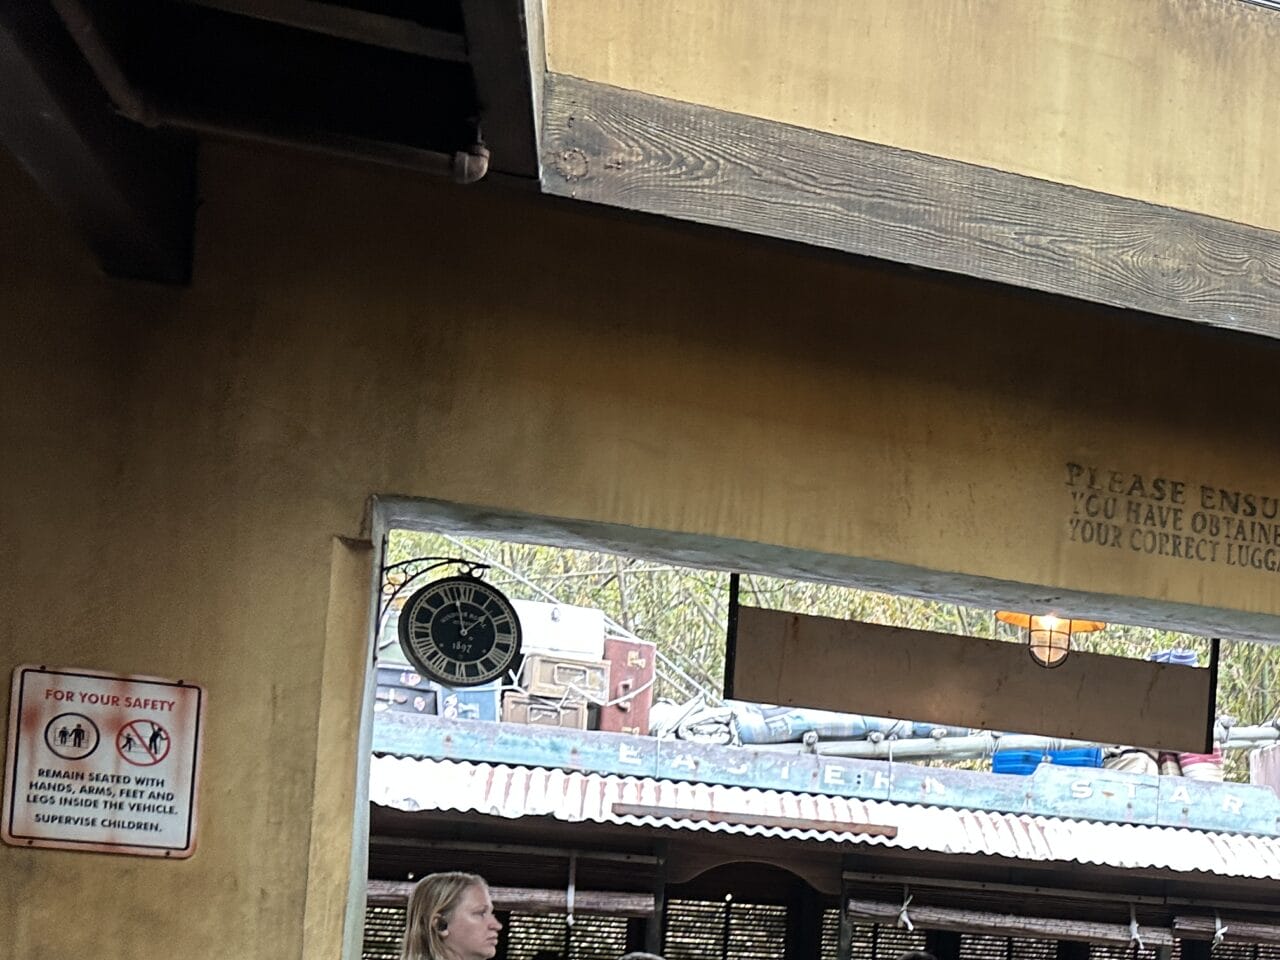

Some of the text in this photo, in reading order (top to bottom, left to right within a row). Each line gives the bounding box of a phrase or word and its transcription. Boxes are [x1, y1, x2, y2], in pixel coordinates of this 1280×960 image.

[1065, 461, 1186, 505] PLEASE
[1071, 491, 1118, 520] YOU
[1126, 500, 1184, 532] HAVE
[1069, 518, 1123, 548] YOUR
[1129, 528, 1220, 563] CORRECT
[45, 689, 176, 712] FOR YOUR SAFETY
[38, 768, 165, 788] REMAIN SEATED WITH
[29, 781, 175, 802] HANDS, ARMS, FEET AND
[1071, 778, 1245, 815] STAR
[26, 794, 178, 815] LEGS INSIDE THE VEHICLE.
[35, 813, 163, 833] SUPERVISE CHILDREN.
